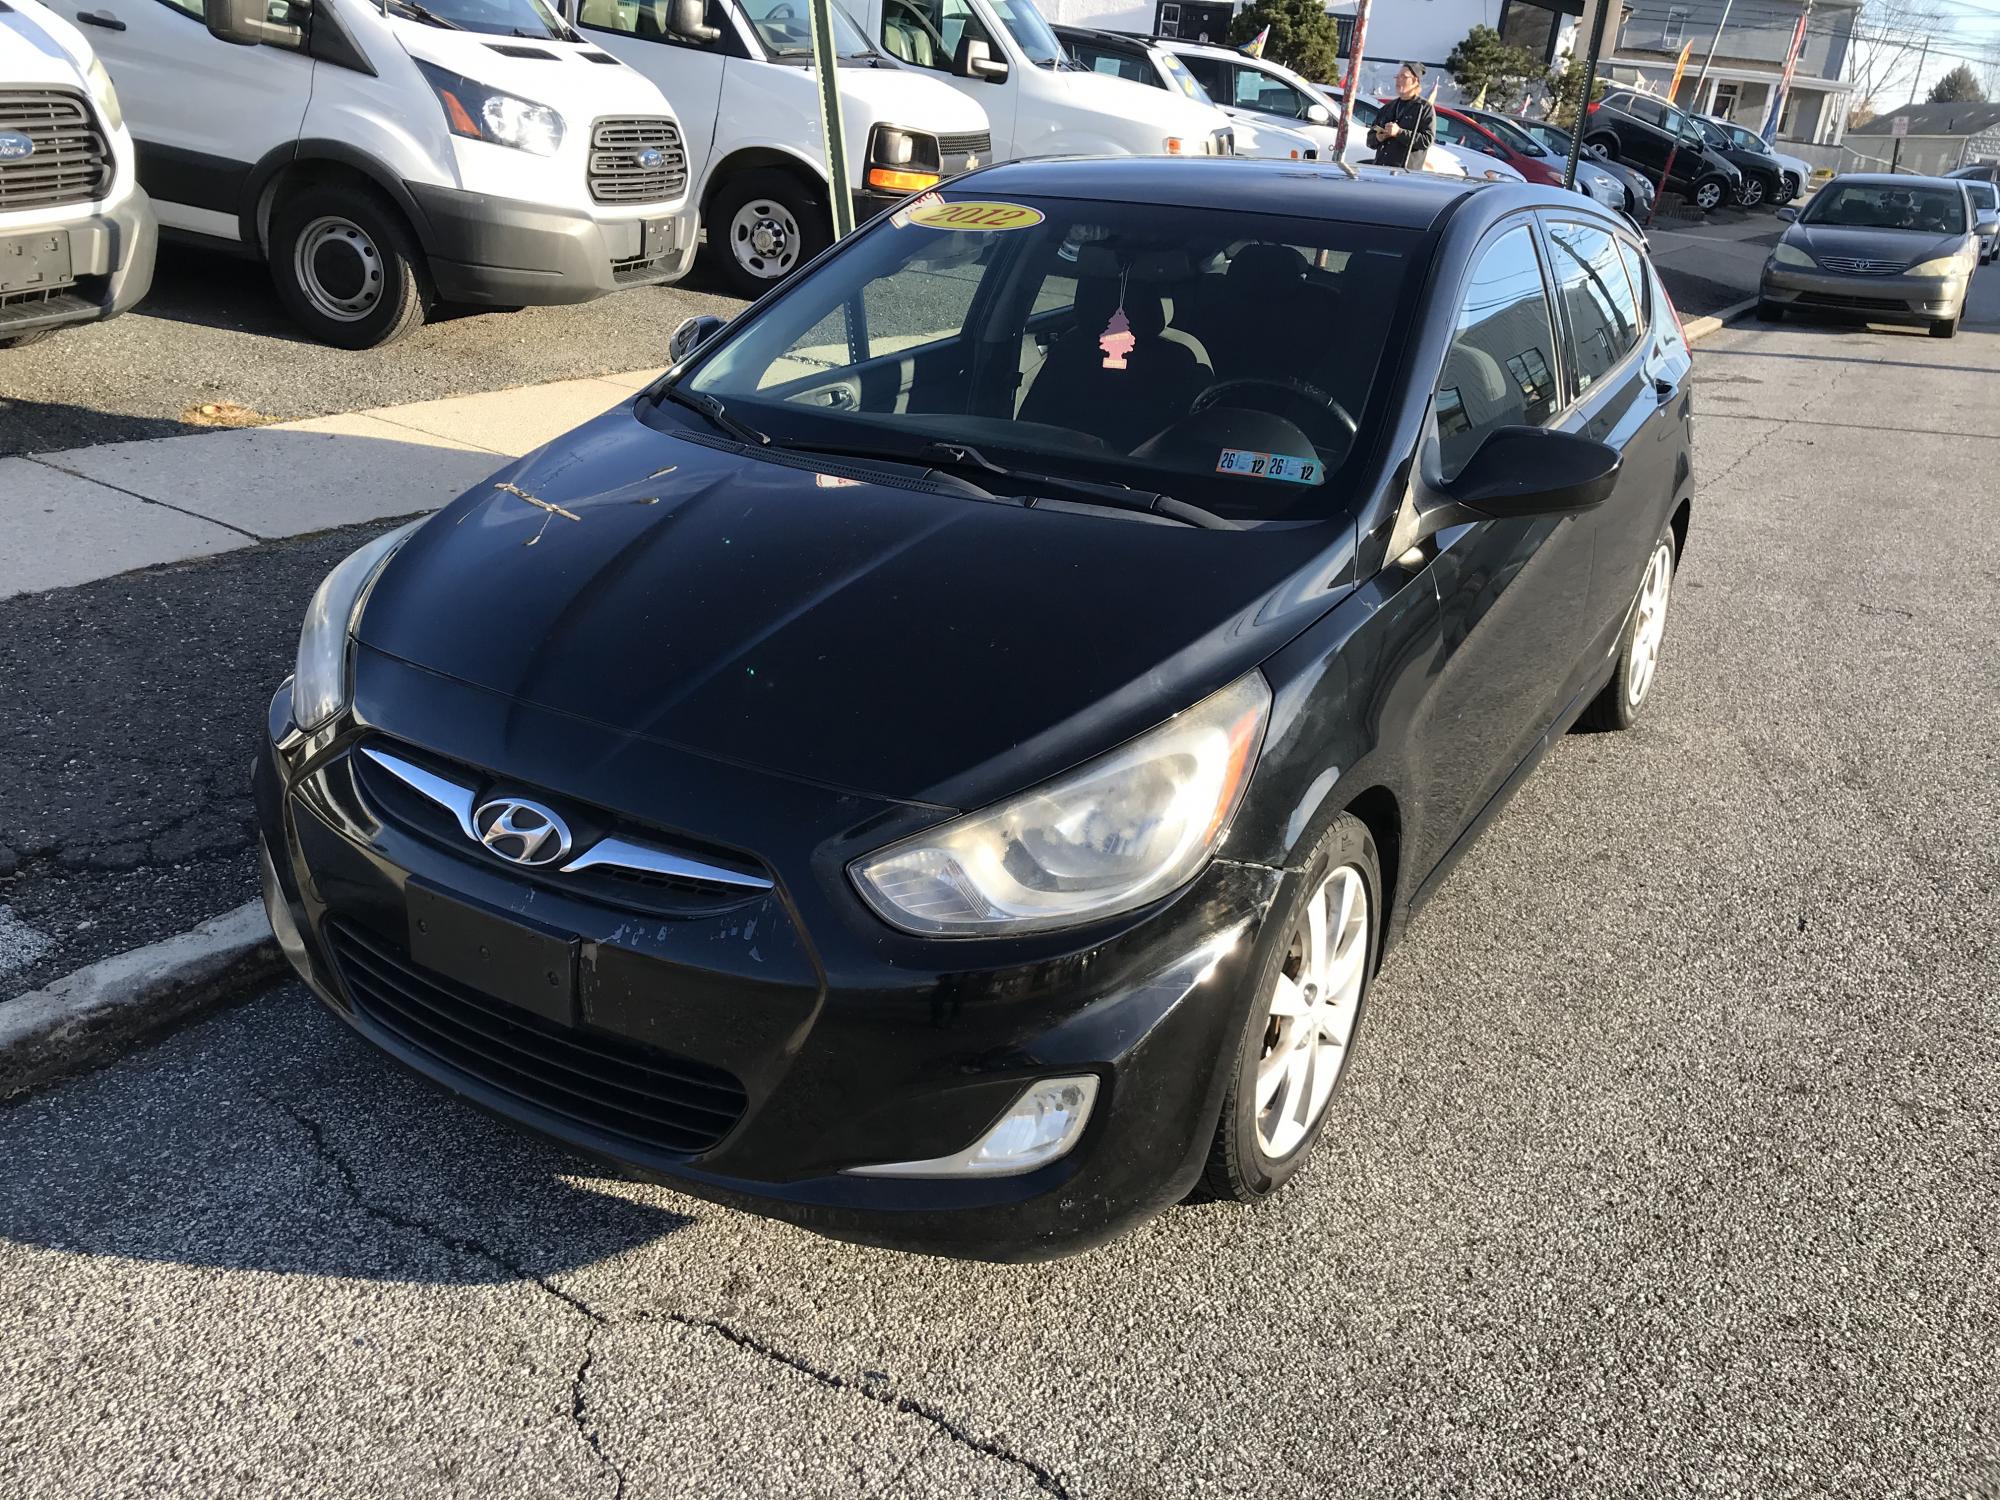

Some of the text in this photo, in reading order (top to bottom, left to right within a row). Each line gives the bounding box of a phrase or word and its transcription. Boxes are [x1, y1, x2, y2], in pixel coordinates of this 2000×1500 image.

[921, 206, 1026, 226] 2012
[1221, 452, 1236, 469] 26
[1251, 459, 1265, 474] 12
[1269, 457, 1285, 475] 26
[1300, 465, 1314, 481] 12
